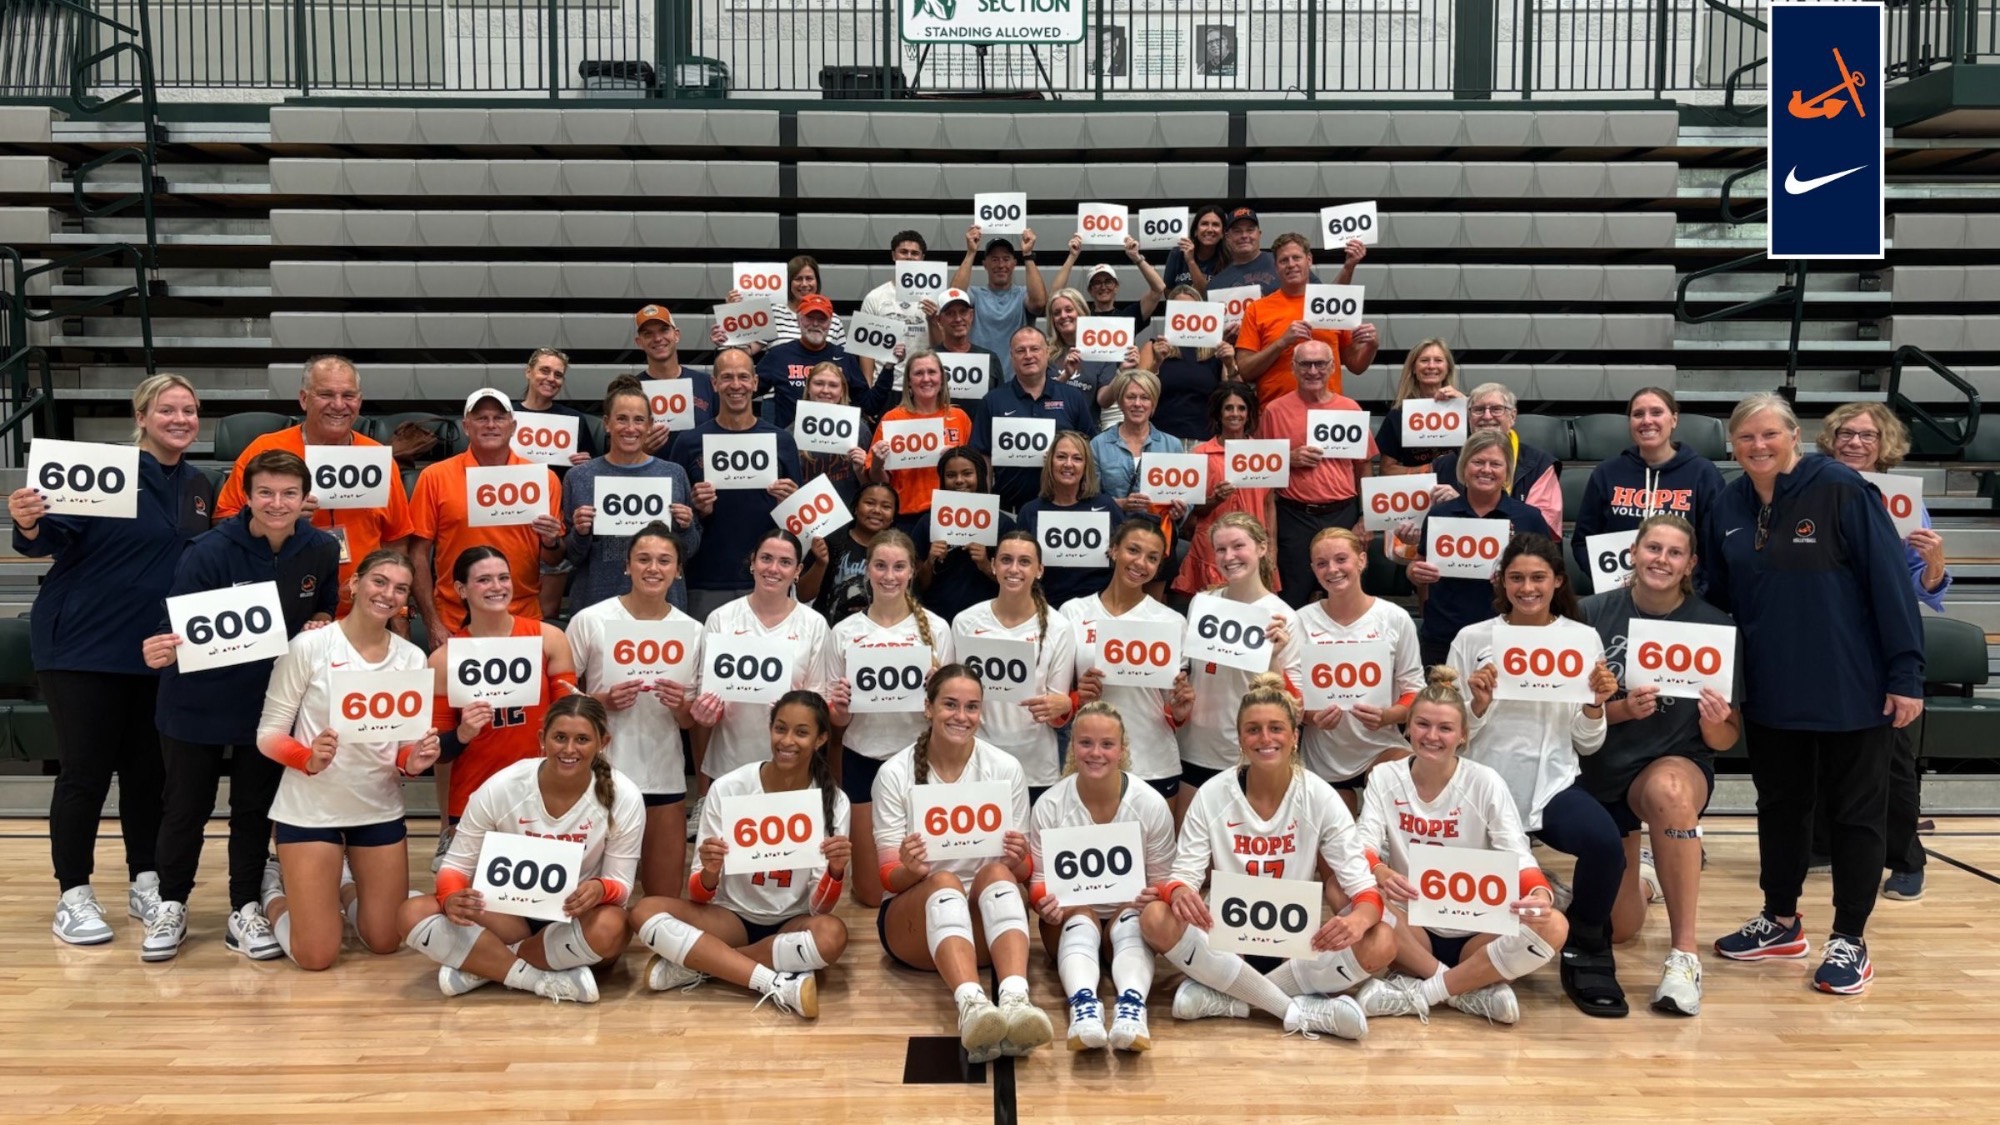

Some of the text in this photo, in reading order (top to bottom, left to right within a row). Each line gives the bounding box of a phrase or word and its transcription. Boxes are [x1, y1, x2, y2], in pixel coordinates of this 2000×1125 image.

[925, 27, 1062, 38] STANDING ALLOWED
[980, 204, 1021, 221] 600
[1083, 215, 1124, 231] 600
[1328, 214, 1372, 235] 600
[1144, 218, 1183, 236] 600
[739, 274, 782, 291] 600
[900, 272, 942, 289] 600
[1310, 297, 1357, 316] 600
[723, 311, 769, 333] 600
[1171, 314, 1218, 333] 600
[853, 326, 897, 350] 600
[1082, 329, 1128, 347] 600
[650, 393, 687, 415] 00
[801, 415, 852, 439] 600
[1313, 423, 1362, 443] 600
[1408, 412, 1460, 431] 600
[517, 426, 571, 449] 600
[890, 432, 939, 454] 600
[998, 431, 1048, 452] 600
[711, 449, 769, 472] 600
[1231, 453, 1283, 473] 600
[38, 461, 126, 494] 600
[315, 464, 382, 490] 600
[1147, 467, 1200, 488] 600
[476, 481, 541, 508] 600
[602, 493, 664, 516] 600
[1371, 490, 1430, 514] 600
[1611, 486, 1692, 511] HOPE
[785, 493, 834, 536] 600
[937, 506, 991, 530] 600
[1044, 527, 1102, 550] 600
[1435, 534, 1500, 560] 600
[1598, 548, 1633, 574] 60
[186, 605, 272, 645] 600
[1197, 614, 1266, 649] 600
[613, 639, 685, 665] 600
[1103, 639, 1171, 667] 600
[1503, 647, 1584, 678] 600
[1638, 641, 1722, 676] 600
[458, 657, 532, 686] 600
[713, 653, 783, 683] 600
[855, 665, 923, 692] 600
[1311, 661, 1382, 689] 600
[341, 690, 423, 721] 600
[733, 813, 813, 848] 600
[924, 803, 1002, 837] 600
[1398, 811, 1459, 839] HOPE
[1233, 833, 1296, 856] HOPE
[1054, 845, 1133, 880] 600
[486, 856, 567, 894] 600
[1420, 869, 1507, 907] 600
[1221, 897, 1308, 934] 600
